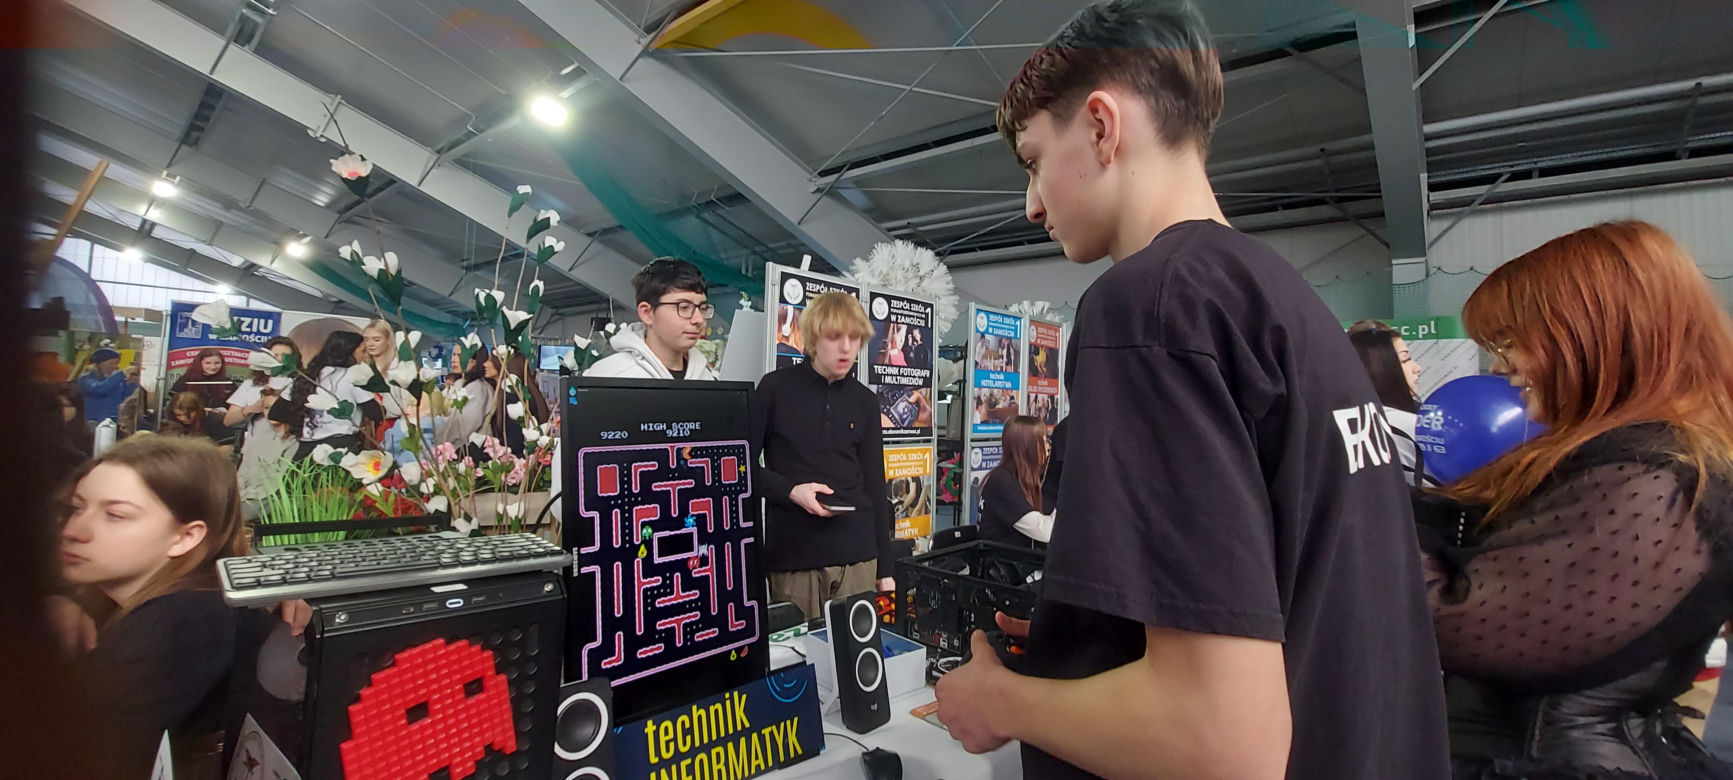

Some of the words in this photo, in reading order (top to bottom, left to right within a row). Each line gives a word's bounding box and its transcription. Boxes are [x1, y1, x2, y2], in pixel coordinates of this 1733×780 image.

[891, 300, 910, 310] ZESPÓŁ
[911, 303, 925, 313] SZKÓŁ
[925, 307, 931, 328] 1
[891, 314, 897, 322] W
[897, 315, 925, 327] ZAMOŚCIU
[1015, 320, 1020, 338] 1
[874, 365, 899, 376] TECHNIK
[600, 430, 628, 440] 9220
[640, 422, 667, 431] HIGH
[672, 421, 701, 431] SCORE
[666, 429, 690, 437] 9210
[1333, 402, 1392, 474] EKO
[924, 452, 930, 473] 1
[644, 690, 750, 764] technik
[650, 716, 803, 780] FORMATYK
